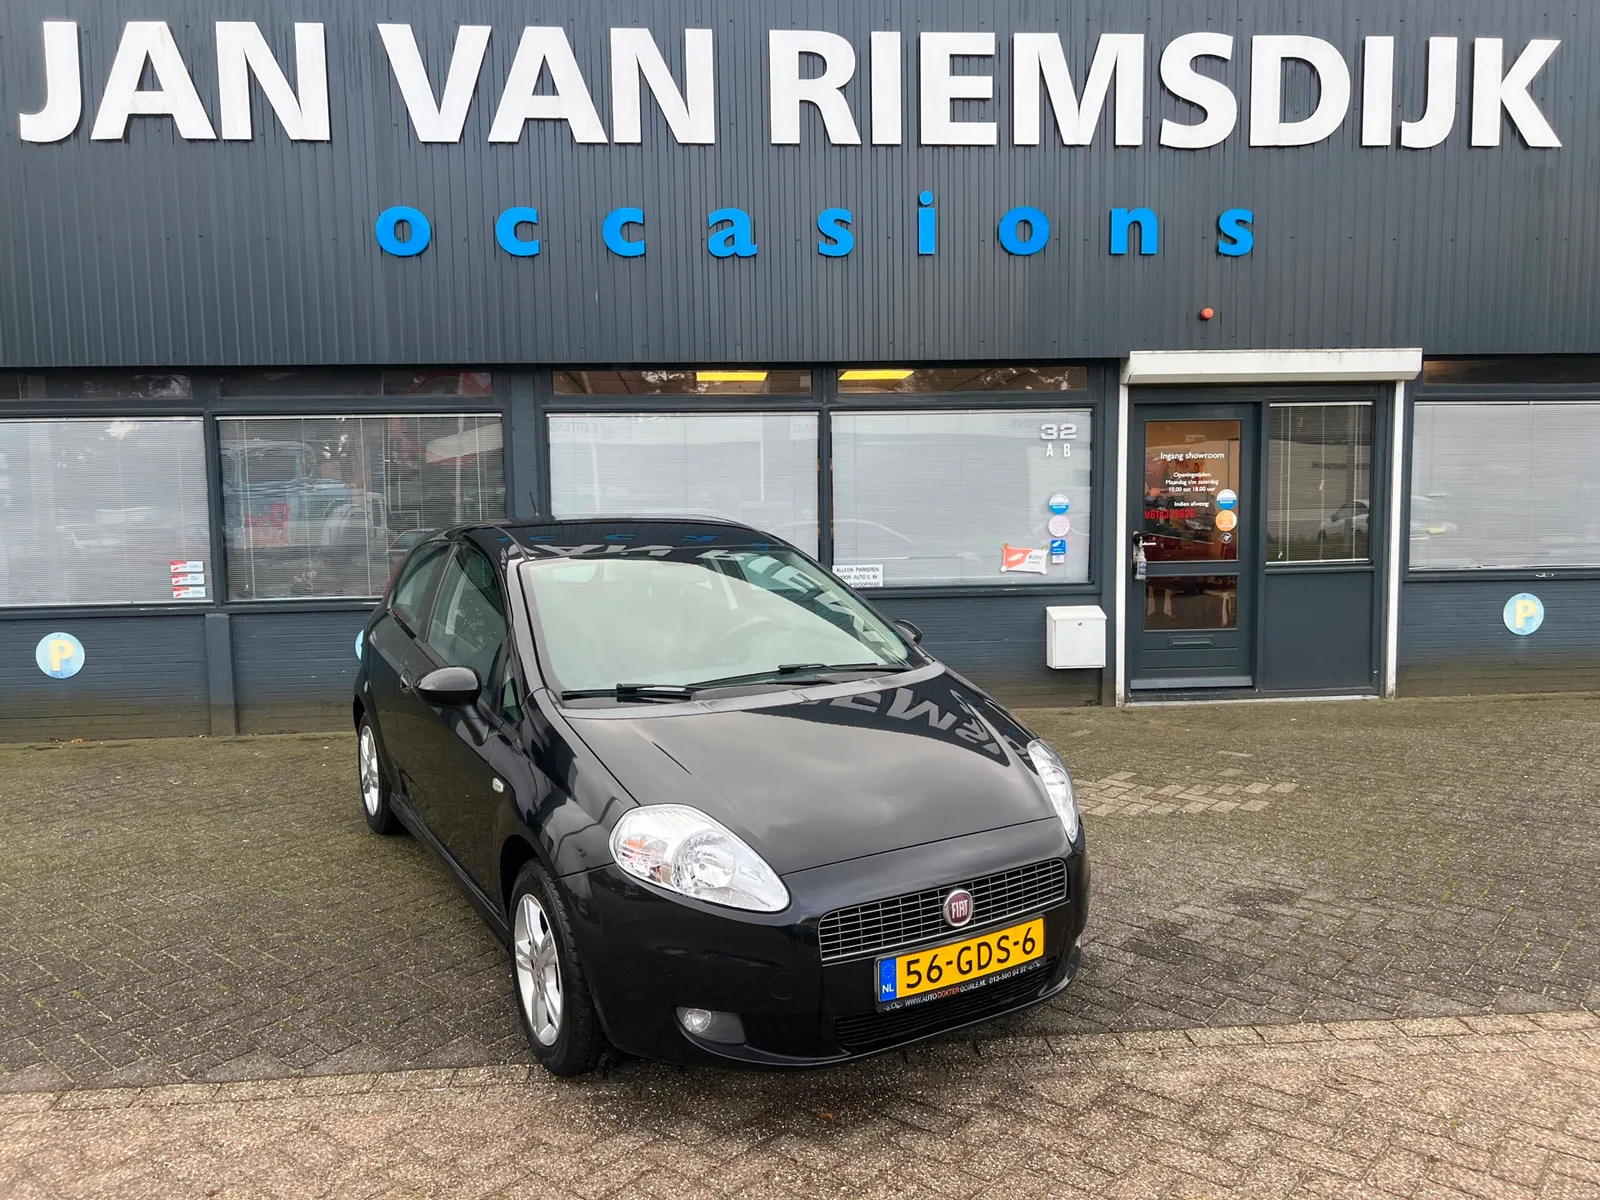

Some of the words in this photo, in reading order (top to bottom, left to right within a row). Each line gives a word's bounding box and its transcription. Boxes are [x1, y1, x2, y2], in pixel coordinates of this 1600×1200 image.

[19, 21, 331, 143] JAN
[376, 23, 716, 145] VAN
[768, 31, 1563, 149] RIEMSDIJK
[1040, 423, 1077, 440] 32
[1045, 443, 1054, 457] A
[1063, 443, 1071, 457] B
[1160, 452, 1183, 461] Ingang
[1185, 451, 1225, 460] showroom
[1515, 599, 1537, 629] P
[50, 639, 75, 672] P
[951, 899, 968, 919] FIAT
[906, 926, 1036, 989] 56-GDS-6
[882, 983, 895, 994] NL
